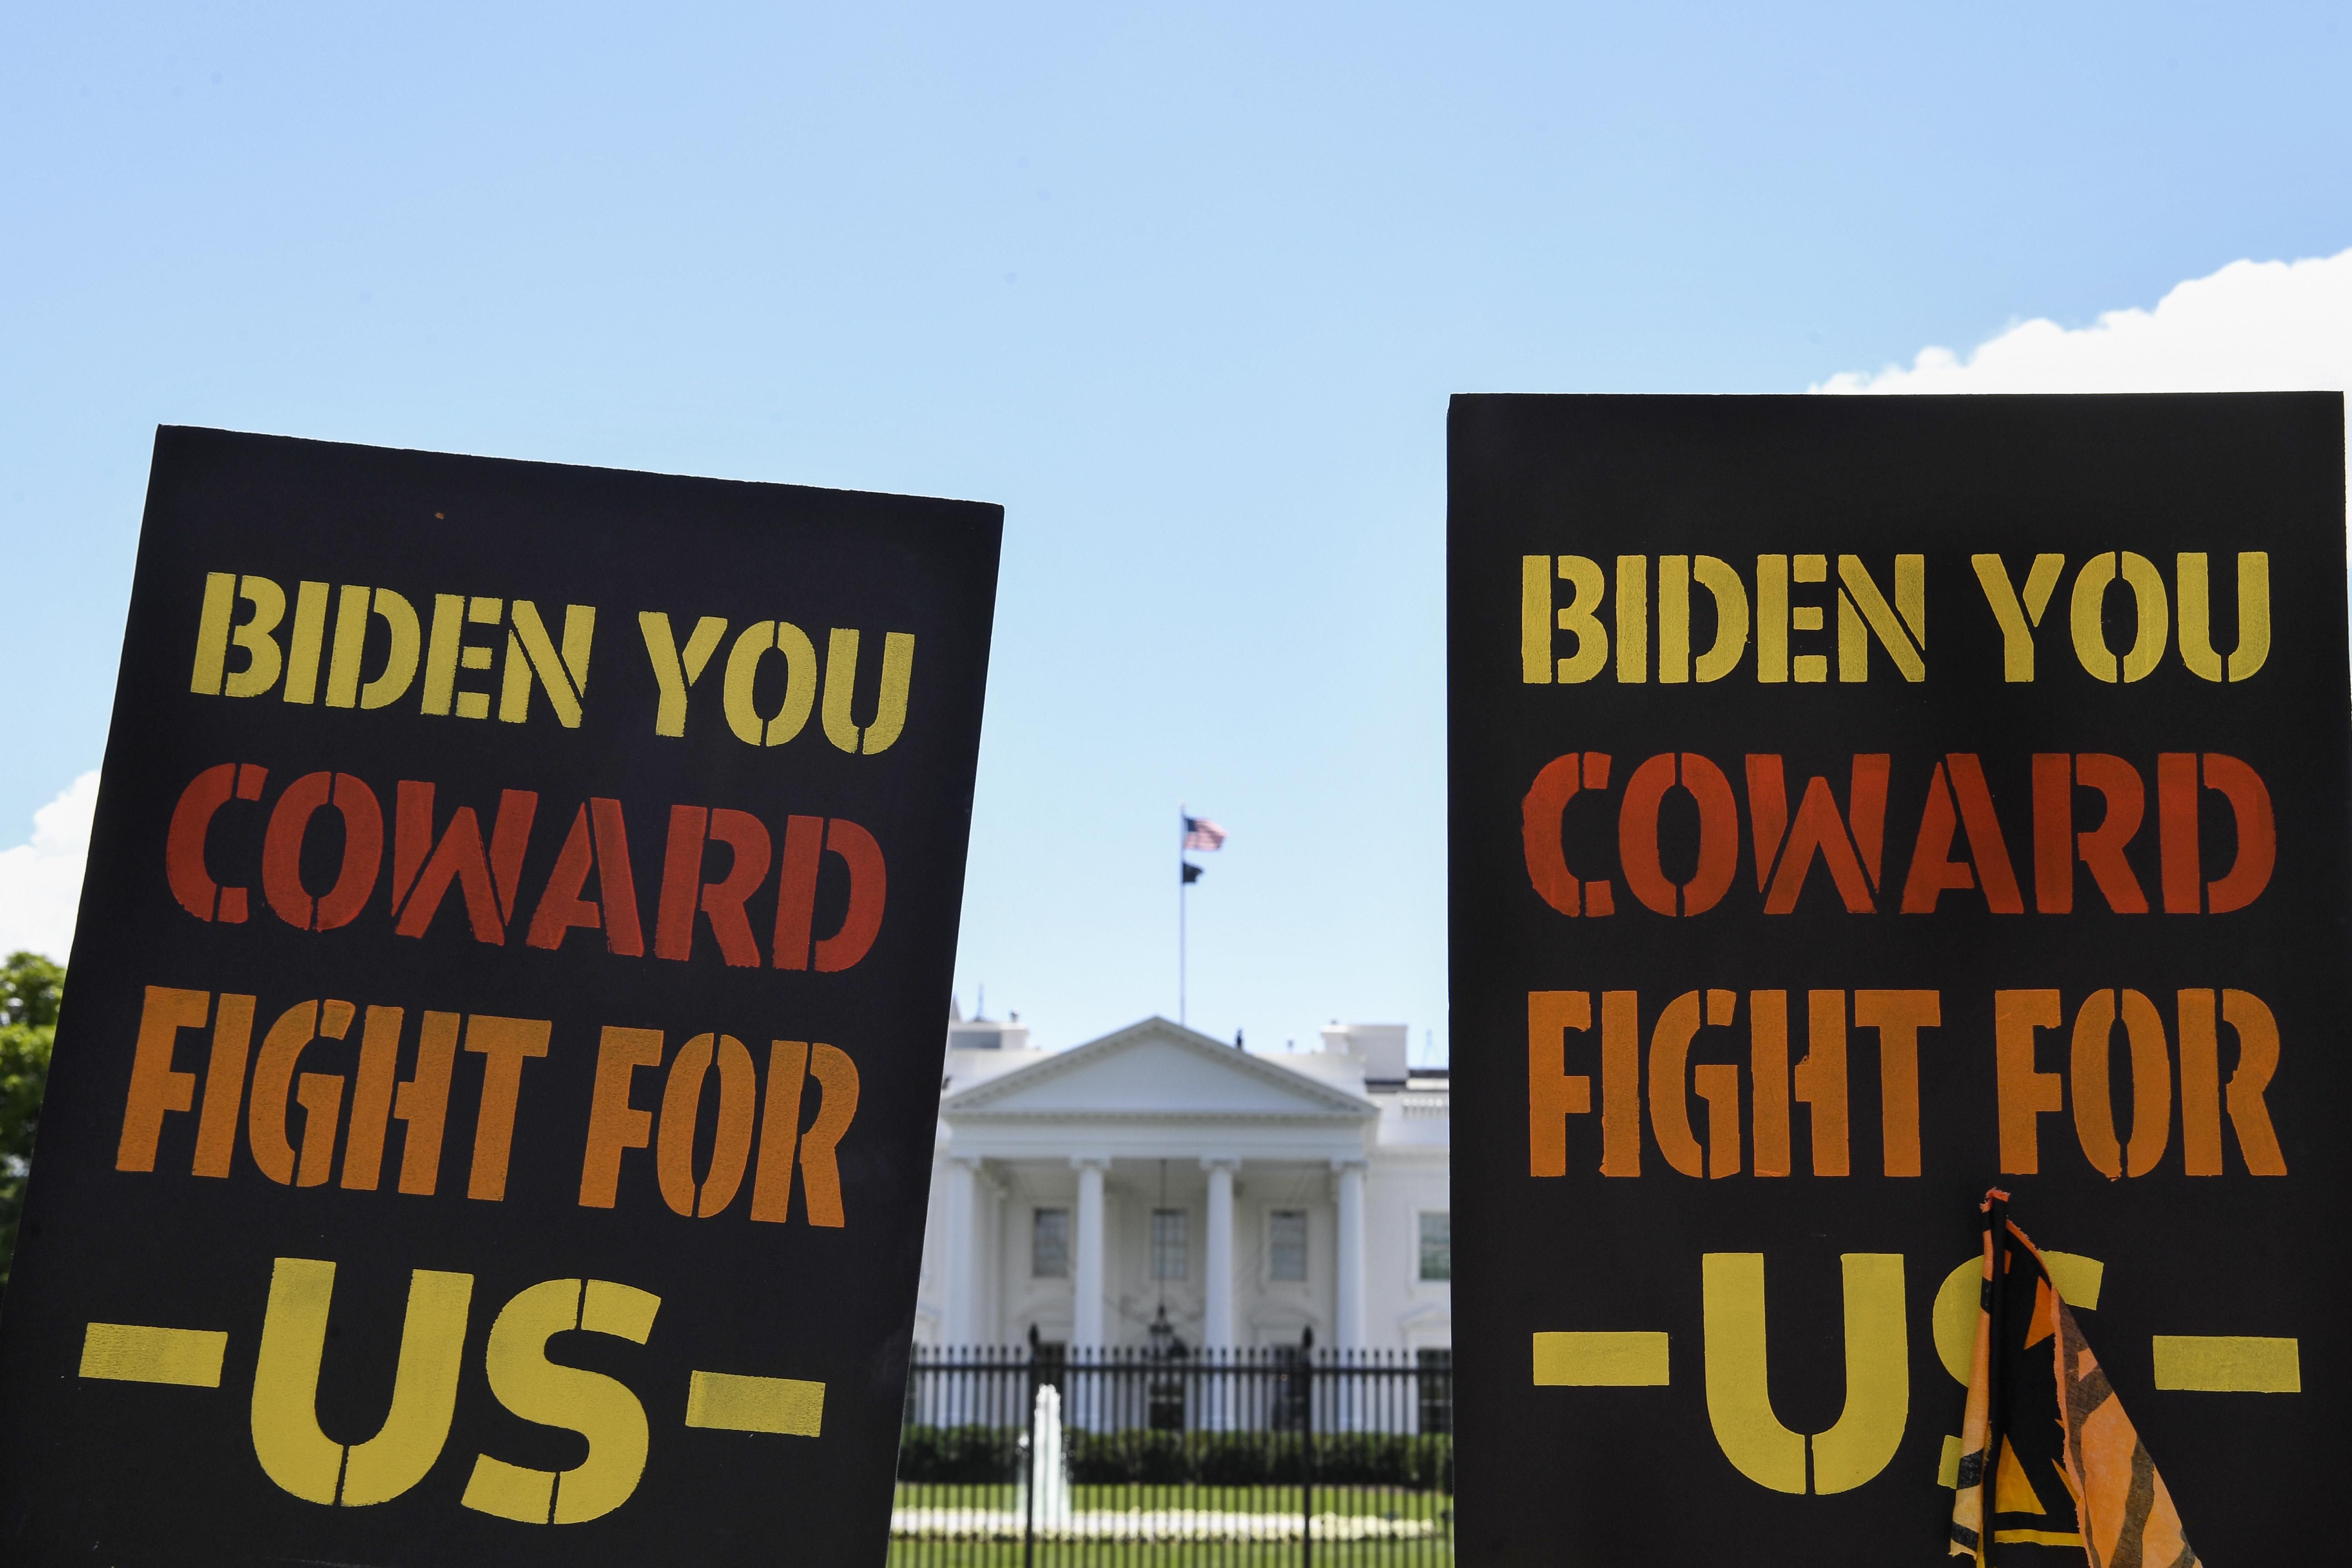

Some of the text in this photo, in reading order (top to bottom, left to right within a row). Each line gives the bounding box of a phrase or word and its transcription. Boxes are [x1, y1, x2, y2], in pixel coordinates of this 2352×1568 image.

[190, 572, 915, 755] BIDEN YOU
[1520, 551, 2271, 685] BIDEN YOU
[166, 762, 887, 973] COWARD
[1522, 751, 2277, 918] COWARD
[115, 984, 860, 1229] FIGHT FOR
[1527, 987, 2288, 1182] FIGHT FOR
